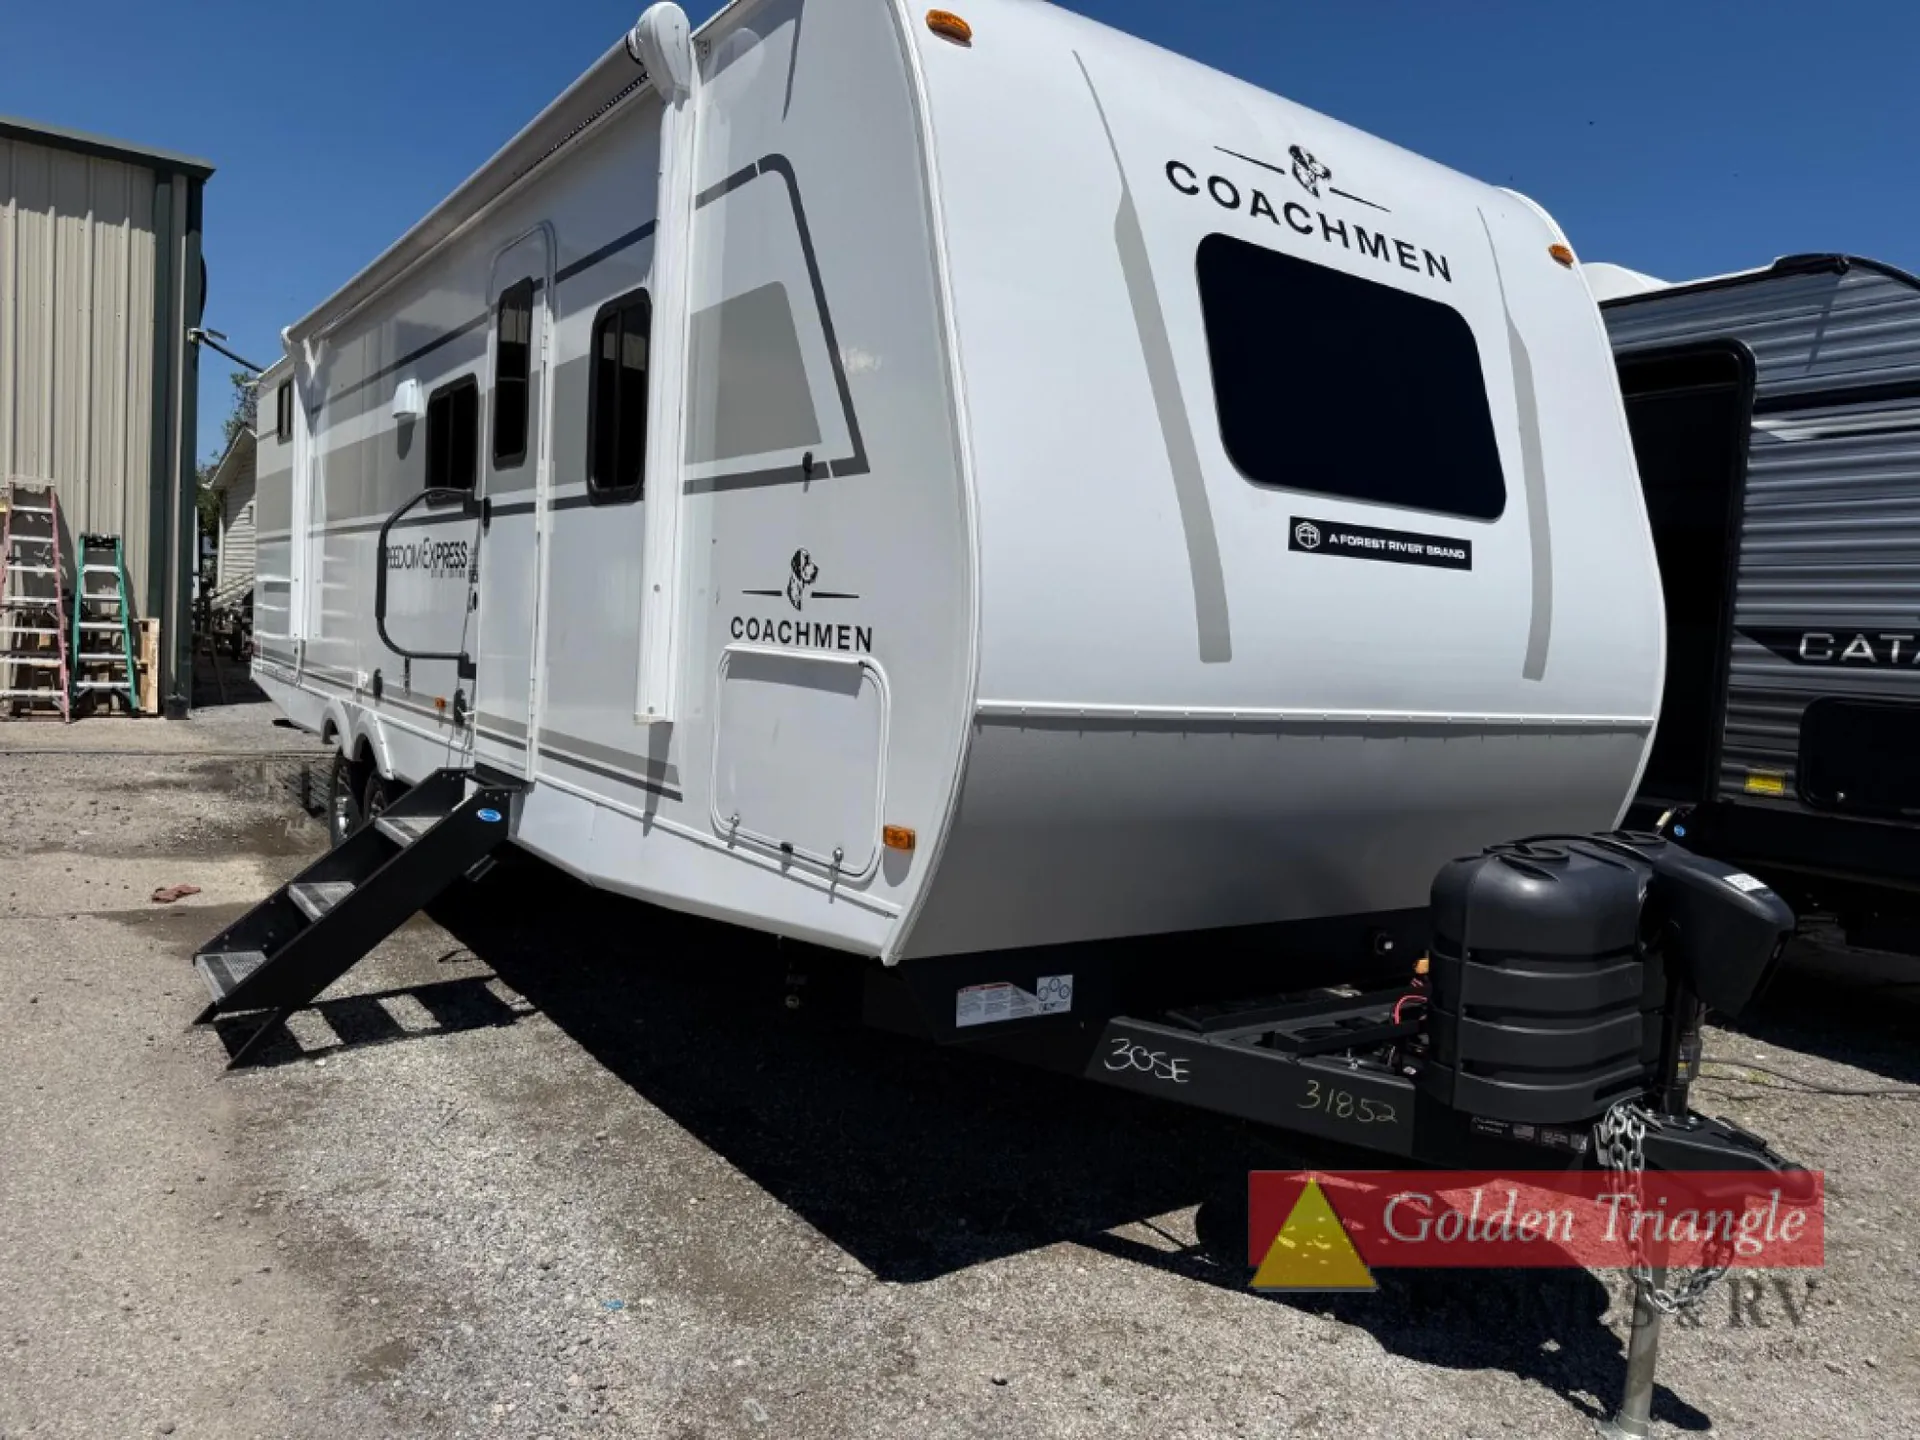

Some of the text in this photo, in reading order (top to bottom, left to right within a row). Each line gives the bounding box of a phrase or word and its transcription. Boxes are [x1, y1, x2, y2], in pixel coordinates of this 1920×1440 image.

[1165, 160, 1452, 283] COACHMEN
[1329, 533, 1466, 560] A FOREST RIVER BRAND
[730, 616, 873, 653] COACHMEN
[1799, 632, 1920, 664] CAT
[1298, 1079, 1398, 1123] 31852
